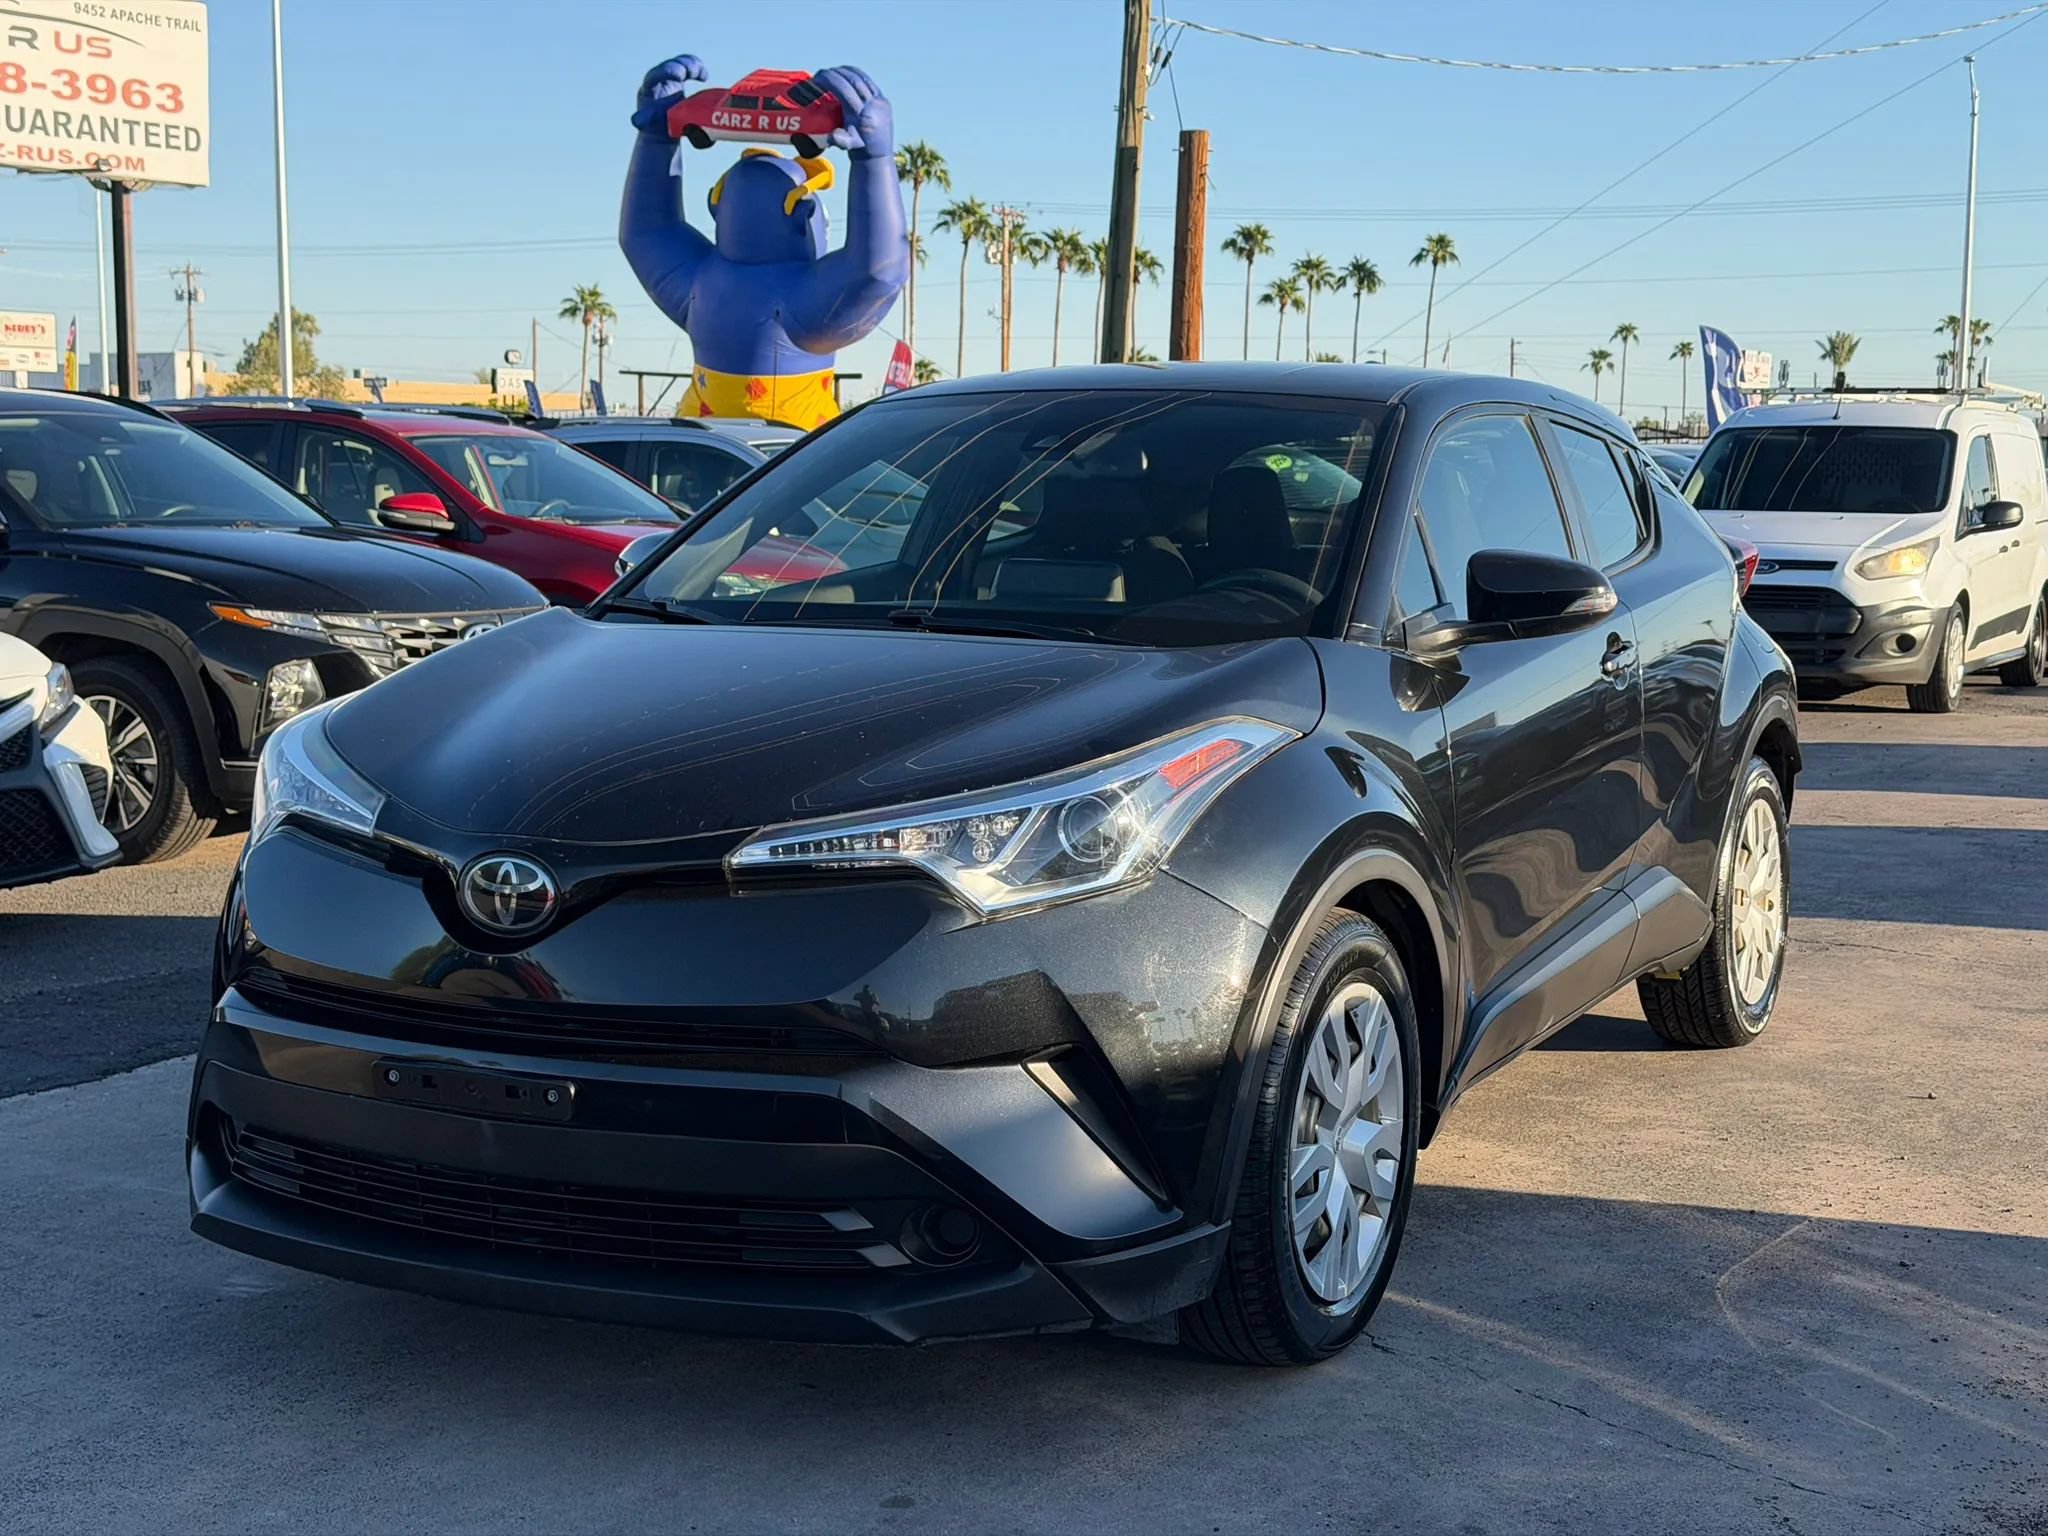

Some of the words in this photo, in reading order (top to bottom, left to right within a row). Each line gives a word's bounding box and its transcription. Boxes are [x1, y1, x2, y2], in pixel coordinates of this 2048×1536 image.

[74, 2, 106, 18] 9452
[110, 10, 162, 27] APACHE
[166, 17, 202, 33] TRAIL
[8, 25, 40, 51] R
[54, 31, 112, 59] US
[711, 111, 752, 129] CARZ
[758, 116, 769, 129] R
[776, 116, 801, 131] US
